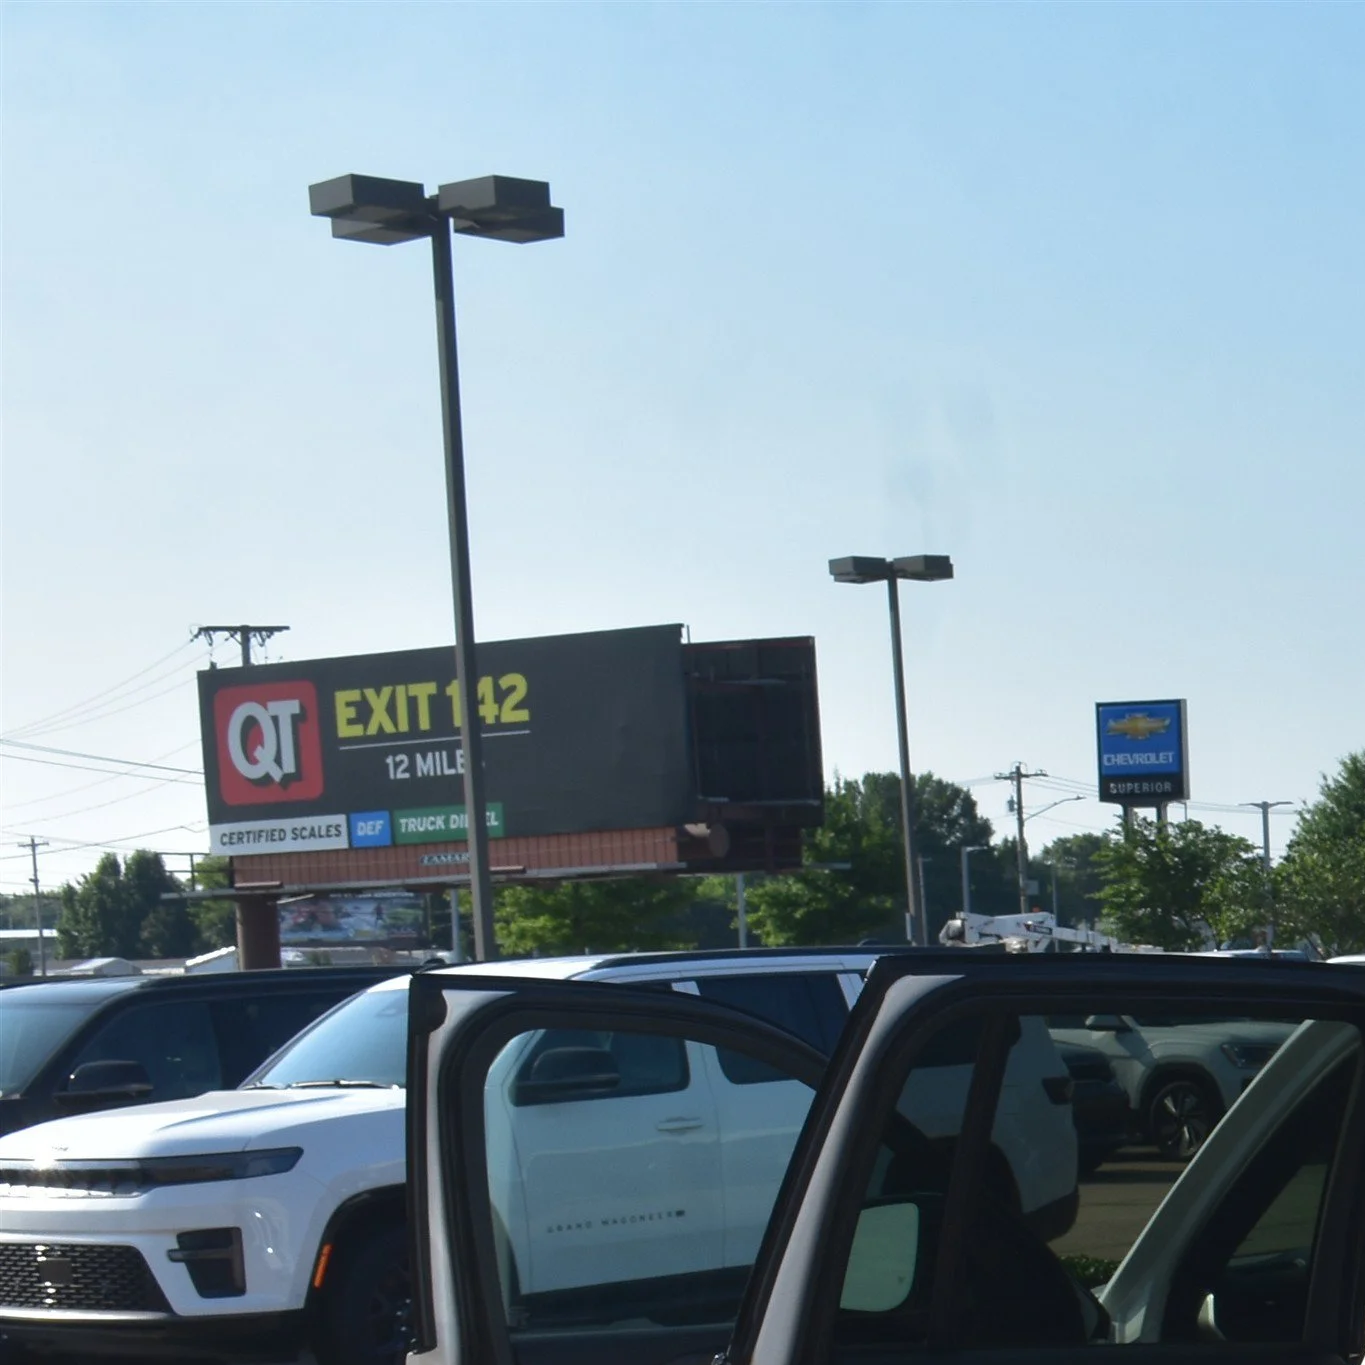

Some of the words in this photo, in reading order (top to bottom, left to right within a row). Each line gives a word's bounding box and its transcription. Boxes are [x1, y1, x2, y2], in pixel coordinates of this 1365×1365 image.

[334, 682, 437, 738] EXIT
[445, 672, 530, 728] 142
[227, 699, 301, 783] QT
[385, 754, 411, 780] 12
[415, 749, 486, 777] MILE
[1103, 751, 1175, 767] CHEVROLET
[1109, 781, 1172, 795] SUPERIOR
[357, 819, 384, 837] DEF
[399, 815, 446, 833] TRUCK
[220, 828, 287, 846] CERTIFIED
[291, 823, 342, 841] SCALES
